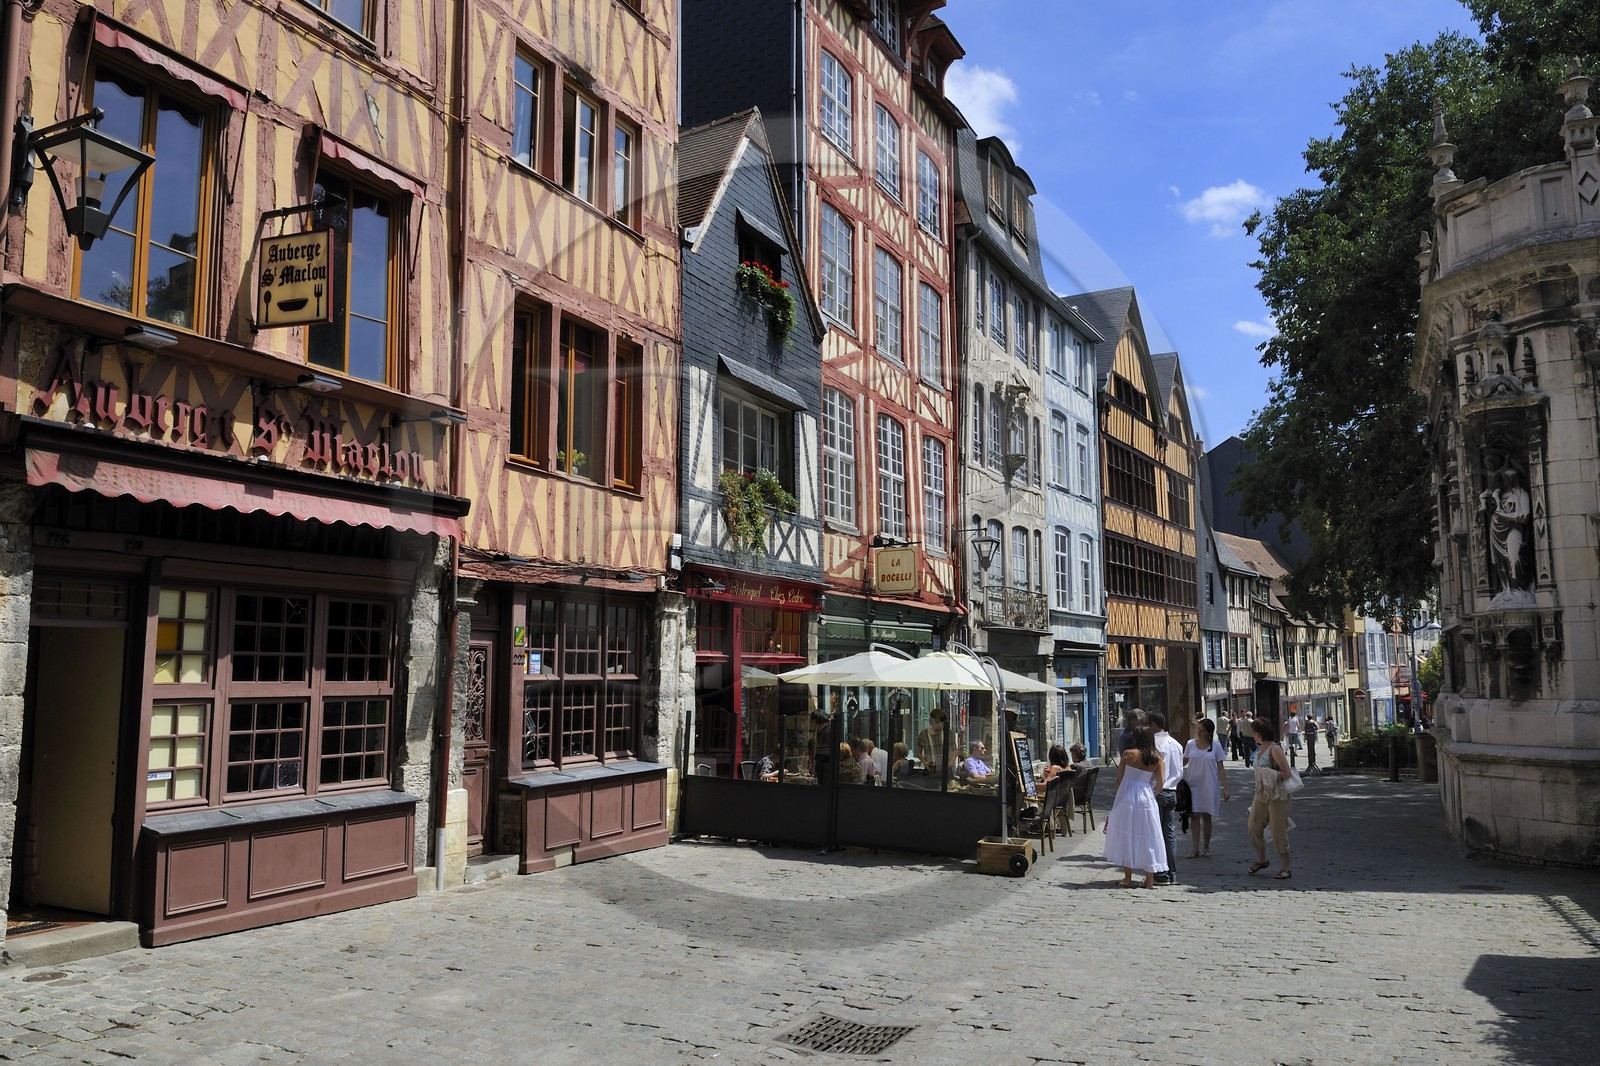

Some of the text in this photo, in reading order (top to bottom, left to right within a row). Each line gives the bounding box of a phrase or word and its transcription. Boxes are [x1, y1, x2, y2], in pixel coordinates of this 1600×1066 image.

[268, 243, 321, 264] Auberge
[278, 263, 326, 287] Maclou
[891, 558, 901, 567] LA
[881, 572, 912, 583] BOCELLI
